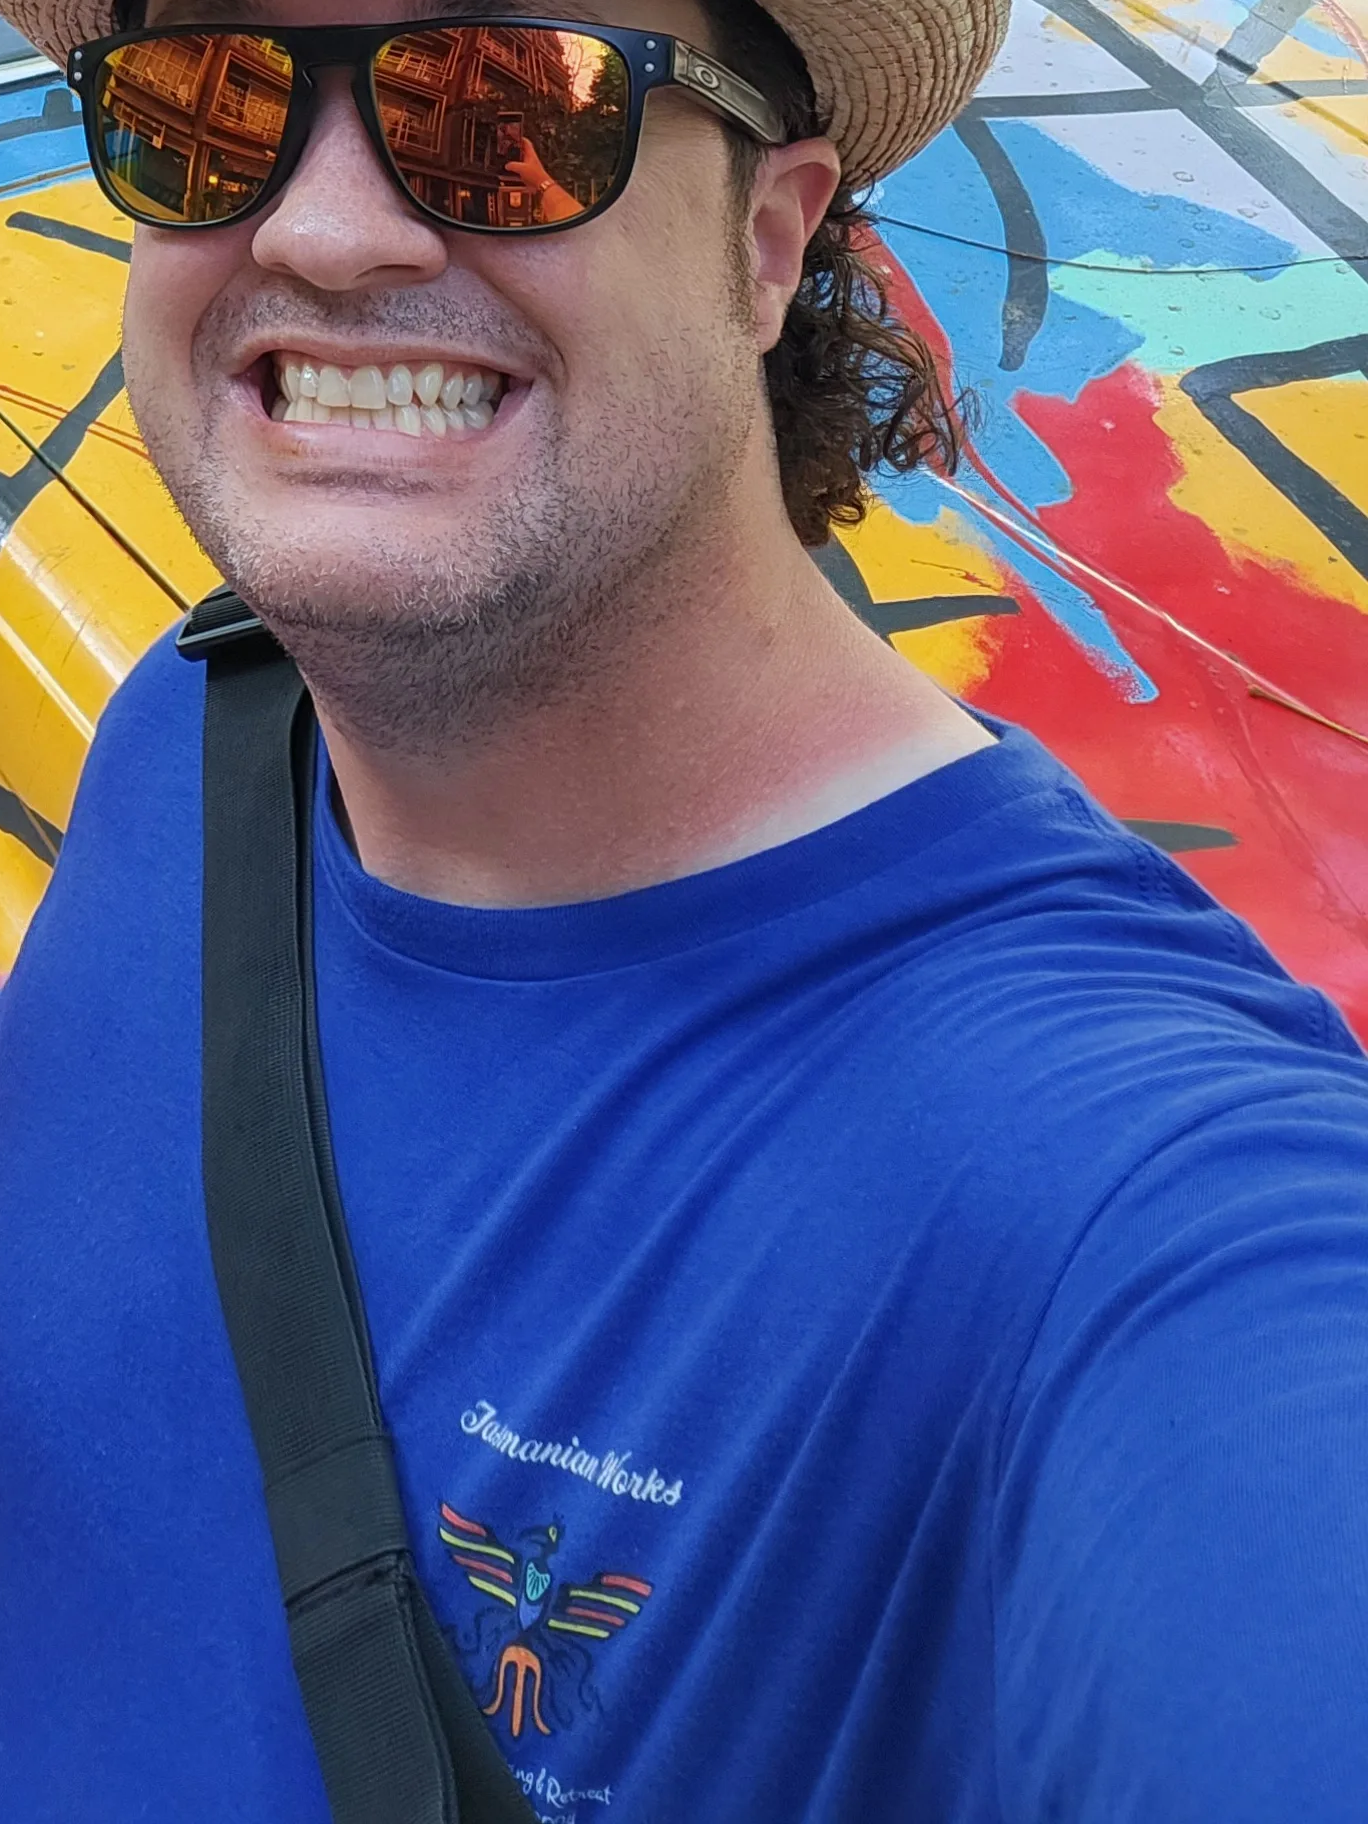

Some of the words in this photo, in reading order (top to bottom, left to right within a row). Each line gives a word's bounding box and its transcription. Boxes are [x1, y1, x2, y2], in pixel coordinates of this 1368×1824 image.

[461, 1399, 599, 1483] Tasmanian
[596, 1450, 683, 1506] Works
[546, 1775, 613, 1809] Retreat
